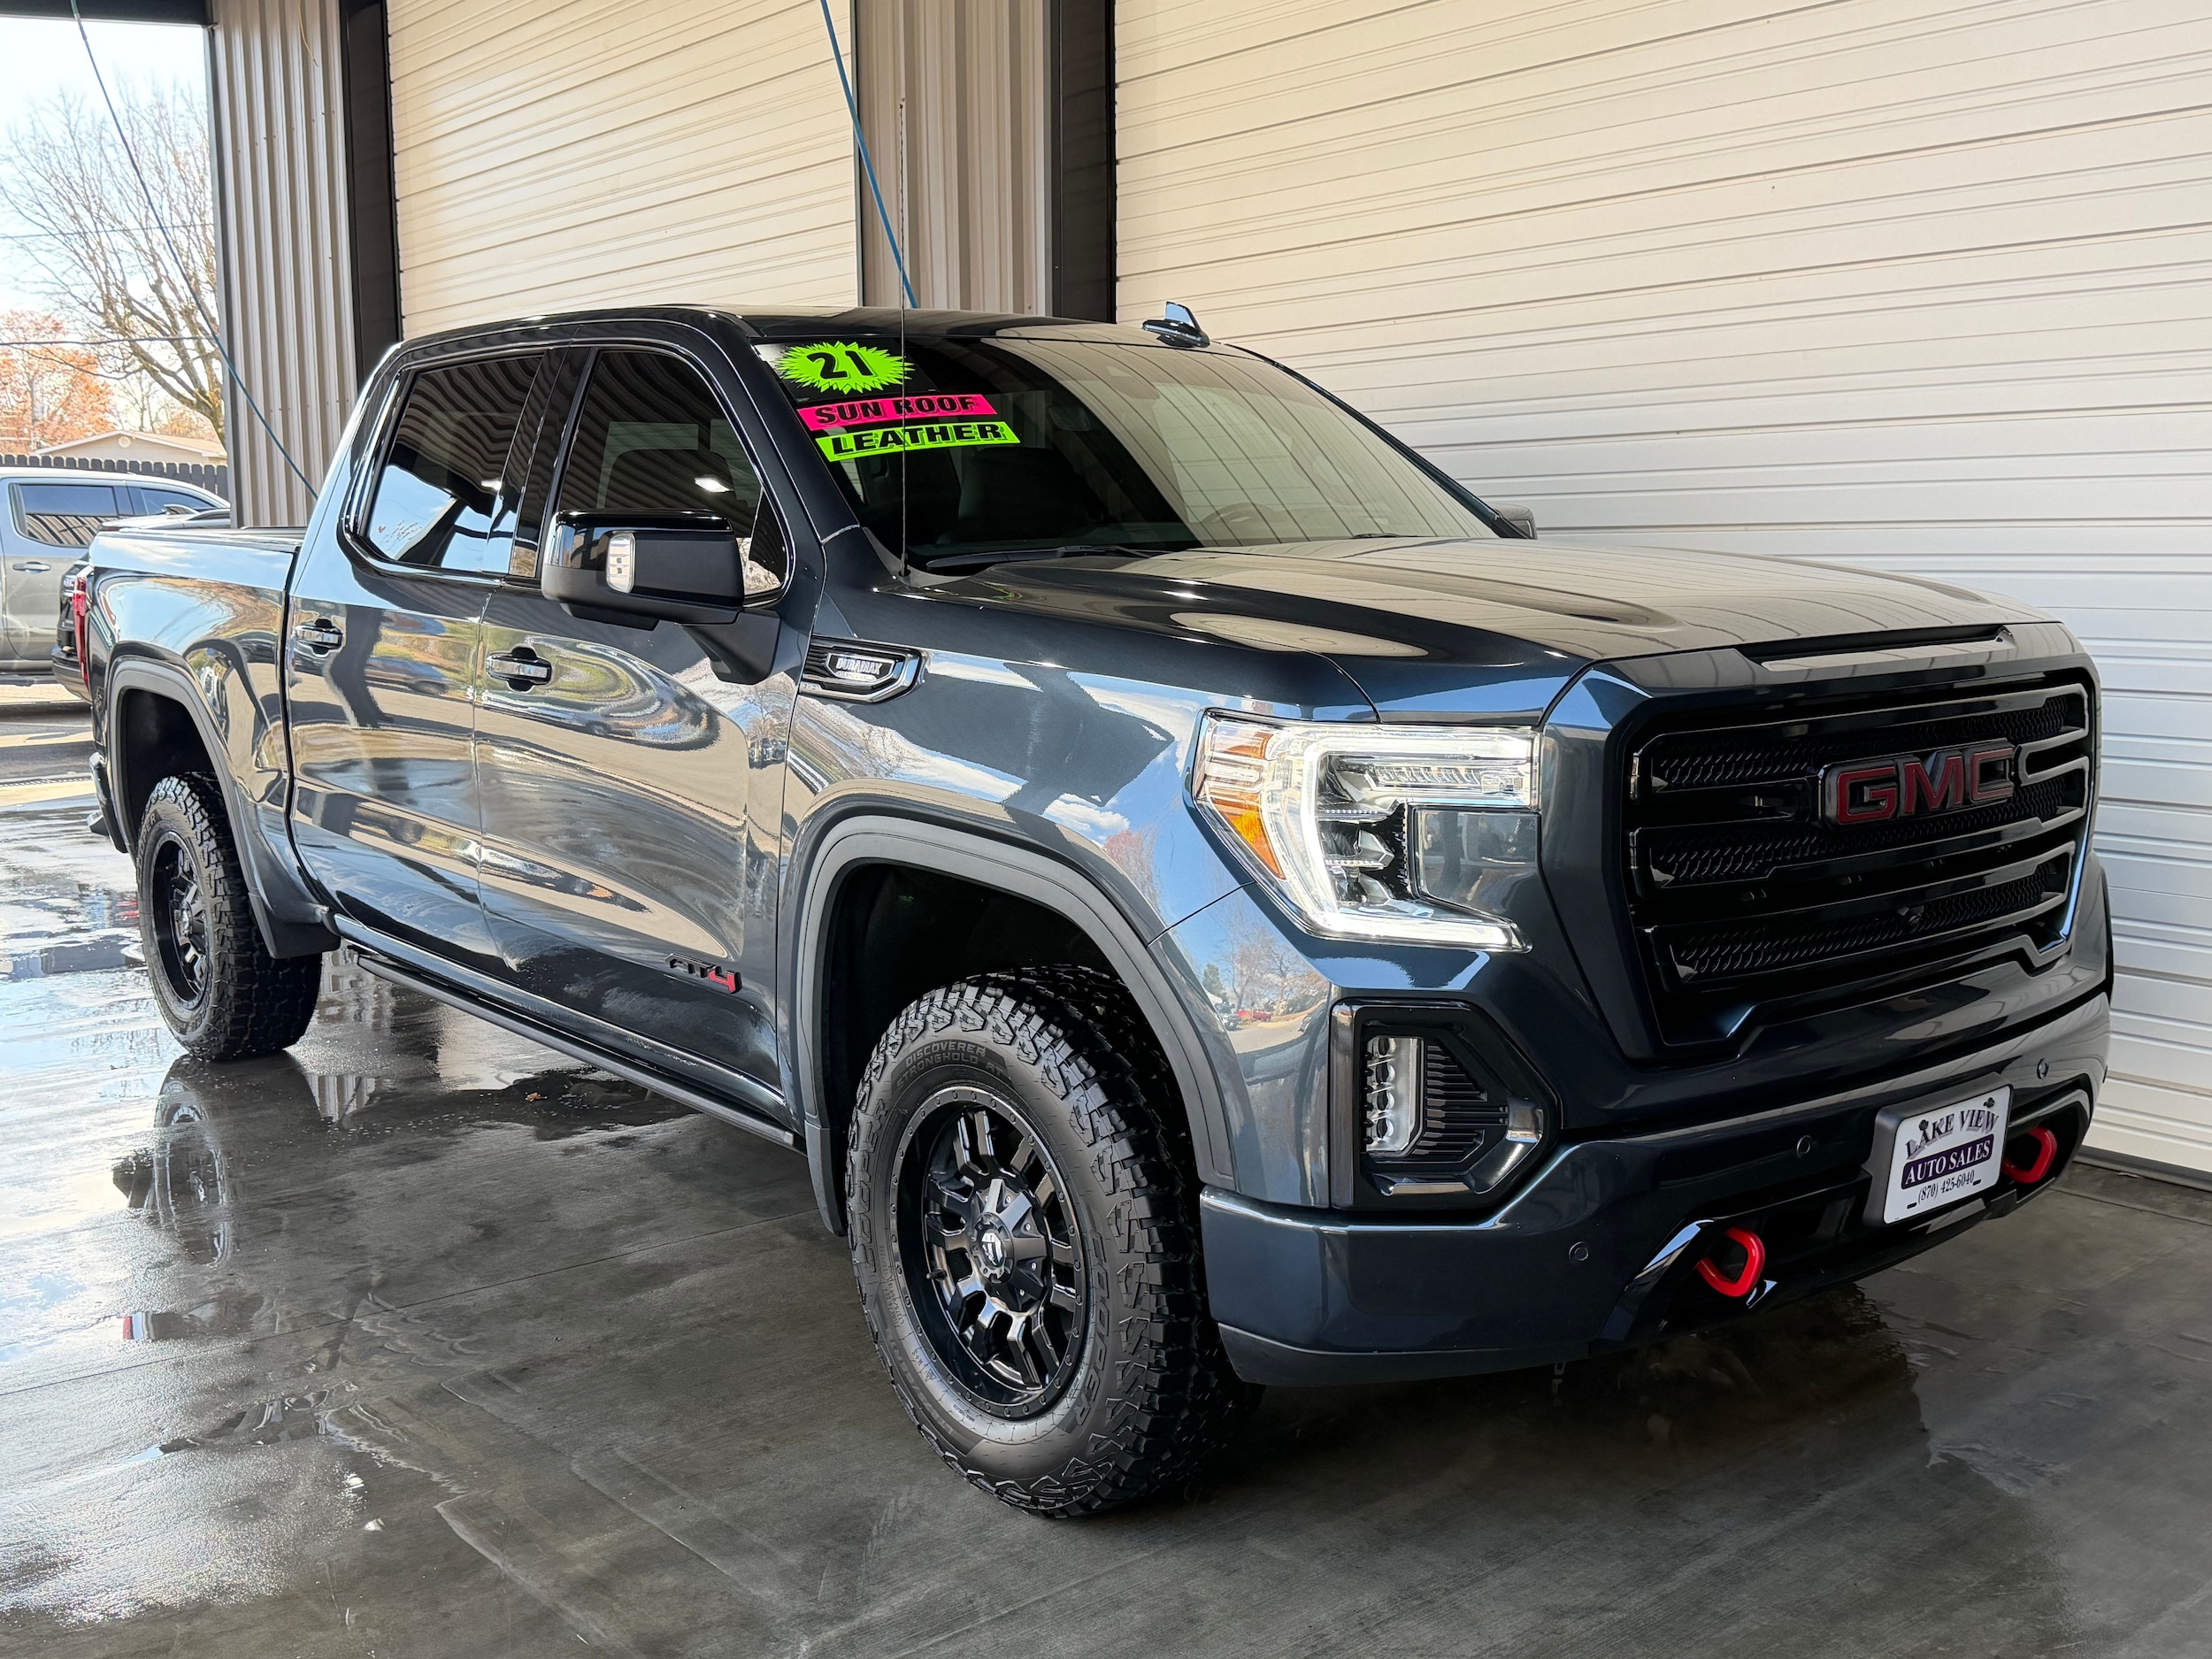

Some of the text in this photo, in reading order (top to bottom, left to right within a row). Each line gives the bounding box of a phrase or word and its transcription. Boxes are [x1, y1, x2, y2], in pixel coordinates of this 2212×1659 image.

[806, 350, 874, 380] 21
[815, 396, 978, 424] SUN ROOF
[832, 424, 1005, 456] LEATHER
[836, 657, 883, 675] DURAMAX
[1834, 743, 2015, 826] GMC
[664, 953, 742, 994] AT4
[896, 1052, 1004, 1090] STRONGHOLD AT
[904, 1041, 987, 1068] DISCOVERER
[1905, 1109, 2000, 1159] LAKE VIEW
[1905, 1140, 1991, 1185] AUTO SALES
[1917, 1170, 1976, 1204] (870) 425-6040
